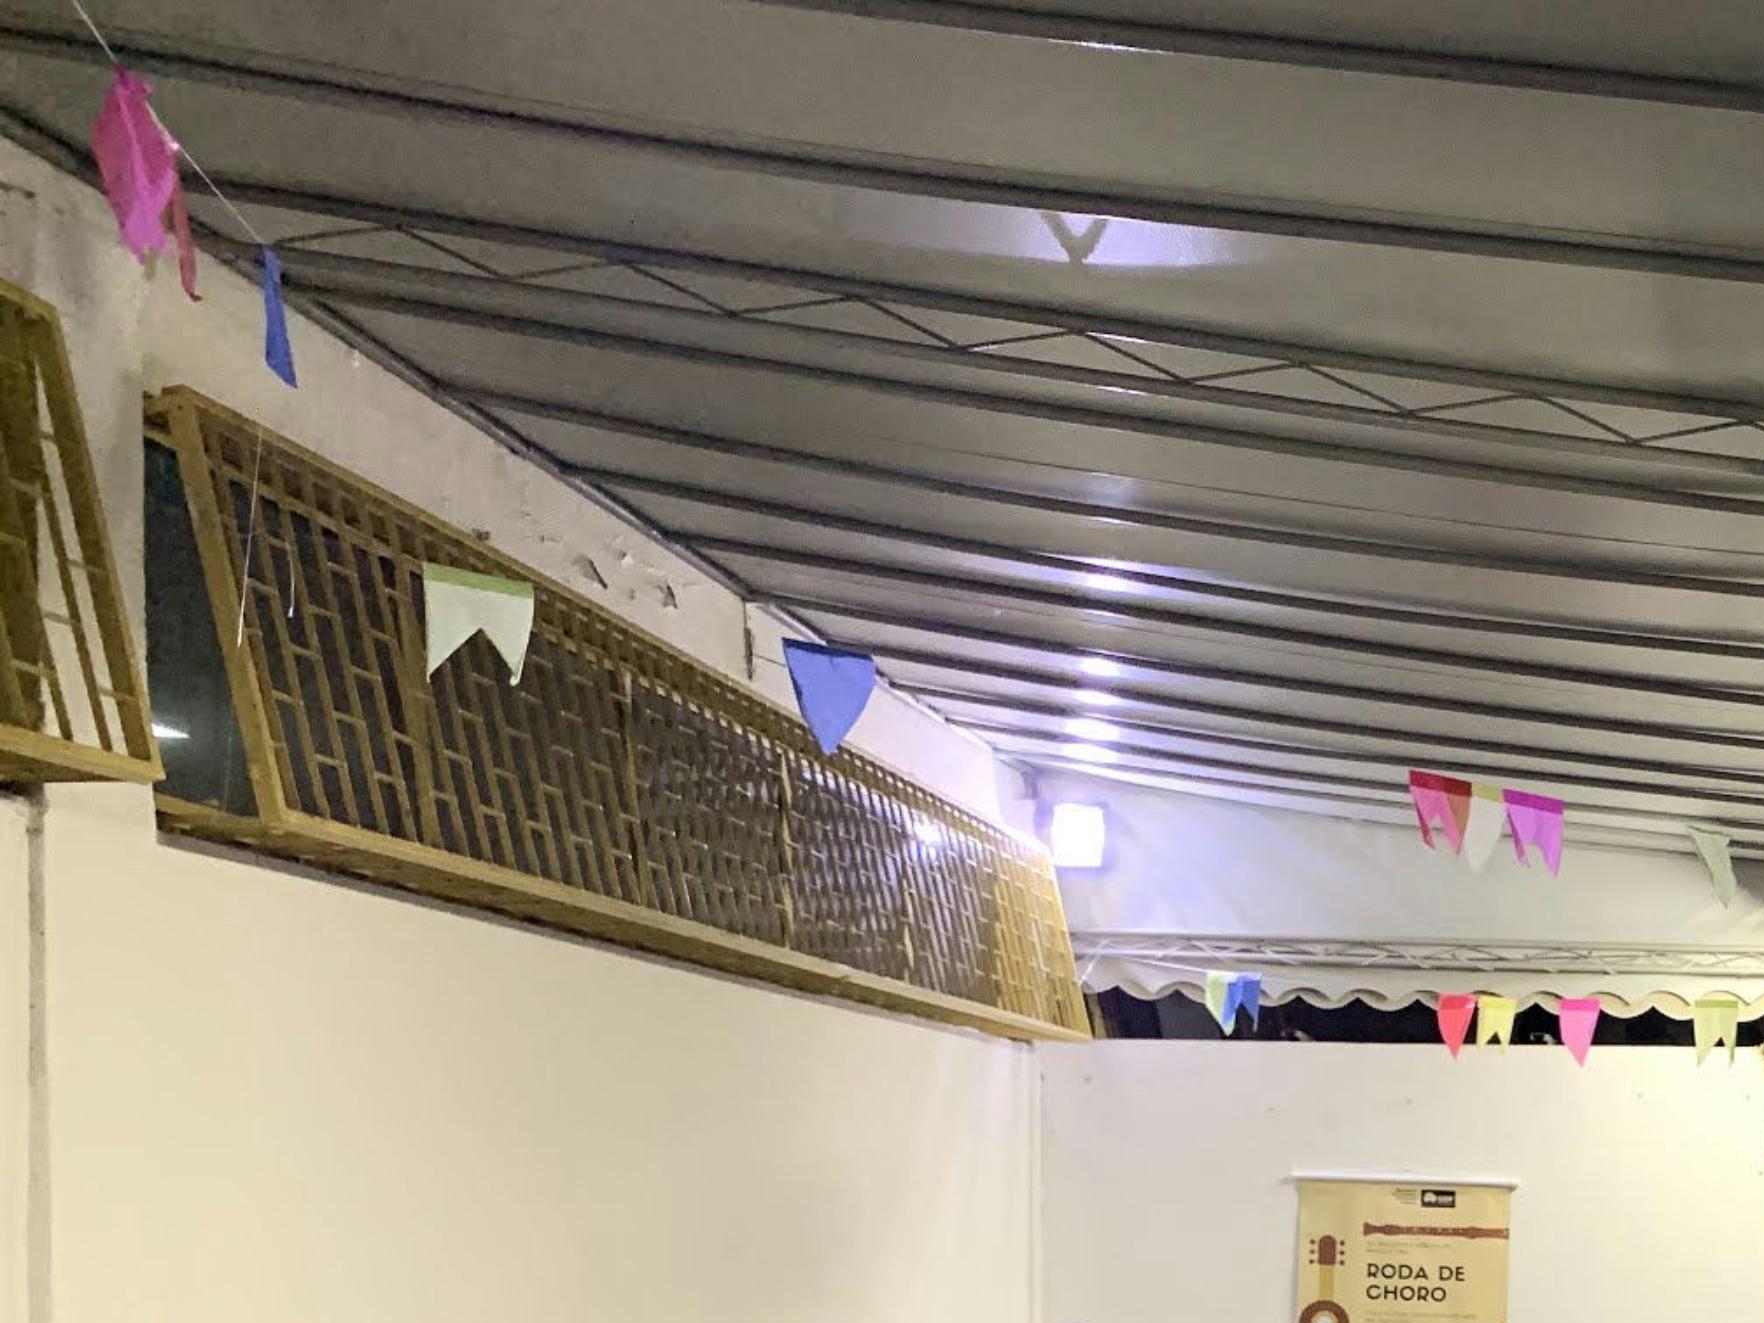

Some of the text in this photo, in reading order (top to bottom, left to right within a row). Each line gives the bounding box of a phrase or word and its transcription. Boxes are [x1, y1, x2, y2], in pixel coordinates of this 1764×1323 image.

[1366, 1263, 1466, 1282] RODA DE
[1366, 1284, 1447, 1302] CHORO
